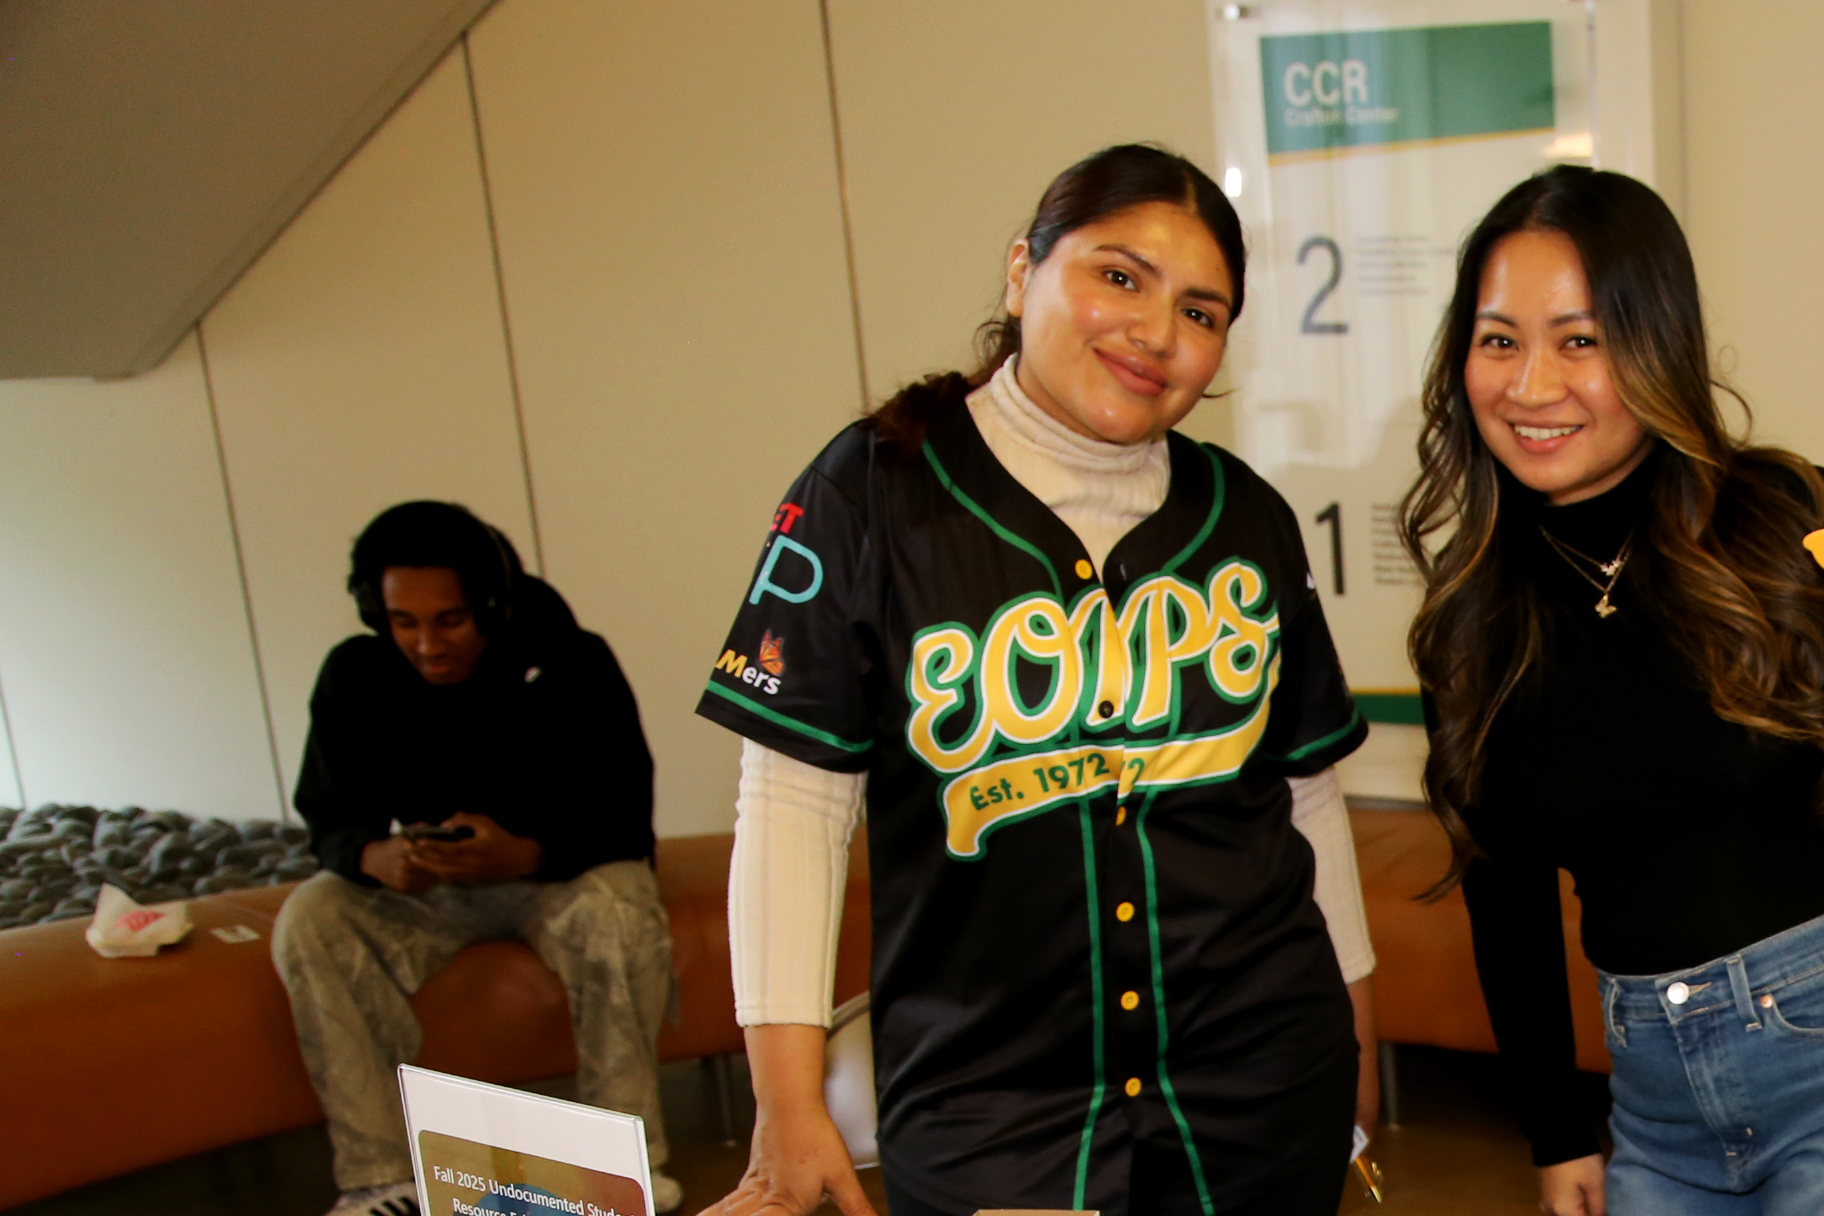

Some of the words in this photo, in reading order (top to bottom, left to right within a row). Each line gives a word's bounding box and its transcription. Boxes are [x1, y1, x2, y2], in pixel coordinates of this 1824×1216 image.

[1284, 59, 1369, 105] CCR
[1296, 236, 1349, 335] 2
[1315, 503, 1346, 595] 1
[969, 779, 1024, 811] Est.
[1034, 751, 1110, 794] 1972
[433, 1165, 455, 1184] Fall
[457, 1171, 487, 1193] 2025
[489, 1180, 585, 1216] Undocumented
